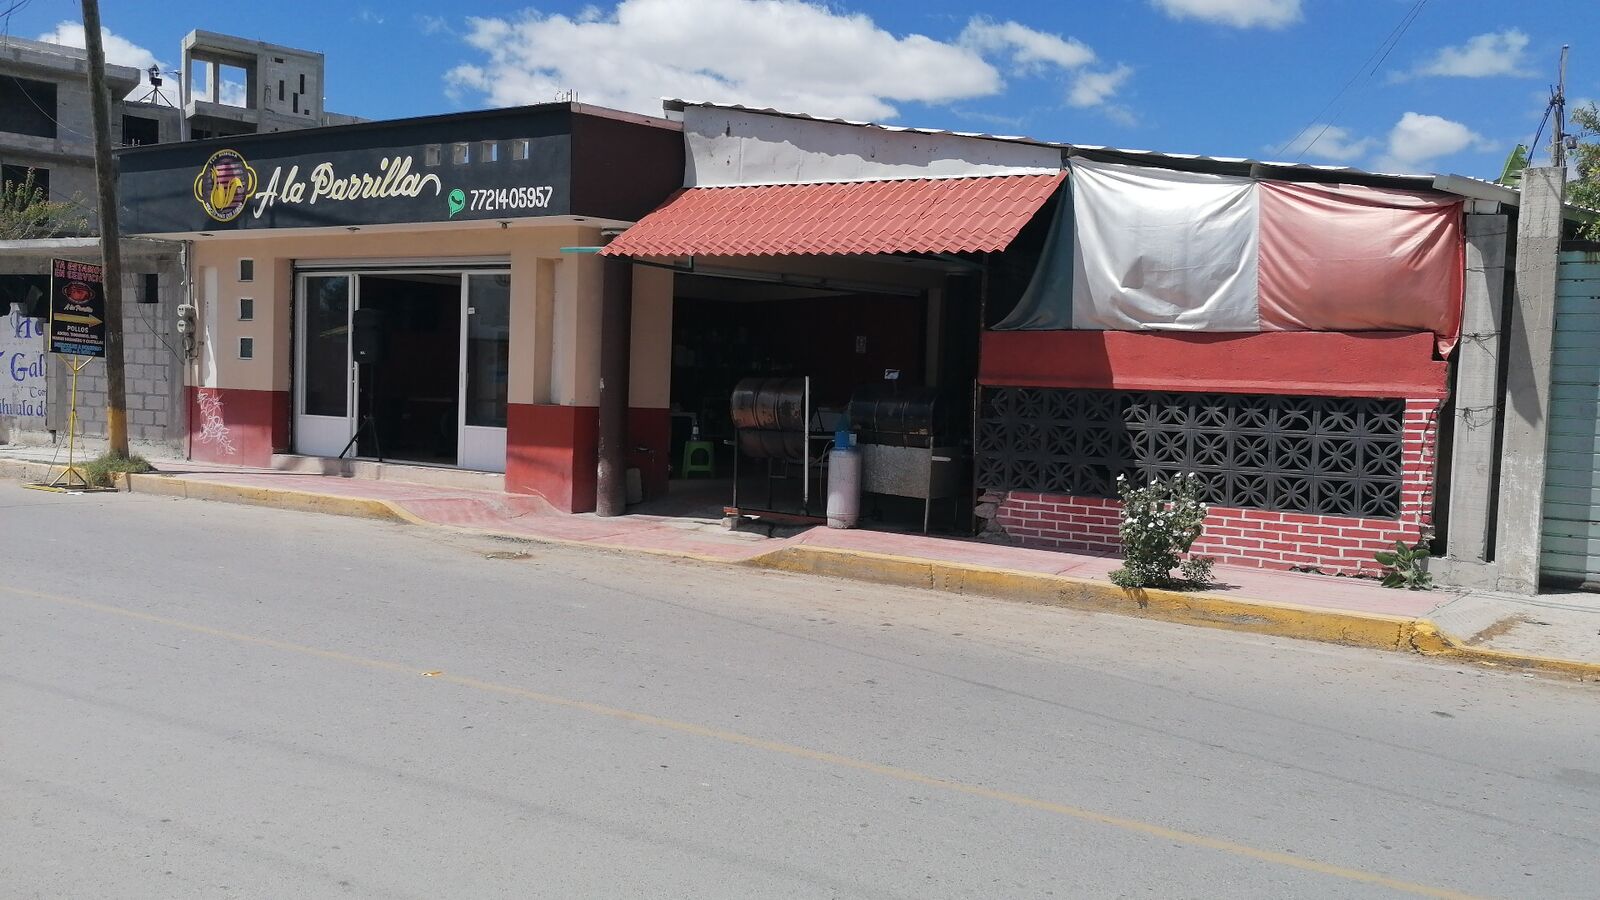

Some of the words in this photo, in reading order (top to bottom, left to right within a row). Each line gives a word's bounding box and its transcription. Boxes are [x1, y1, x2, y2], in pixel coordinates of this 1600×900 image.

[310, 155, 441, 205] Parrilla
[470, 186, 553, 211] 7721405957
[54, 260, 66, 270] YA
[66, 325, 89, 334] POLLOS
